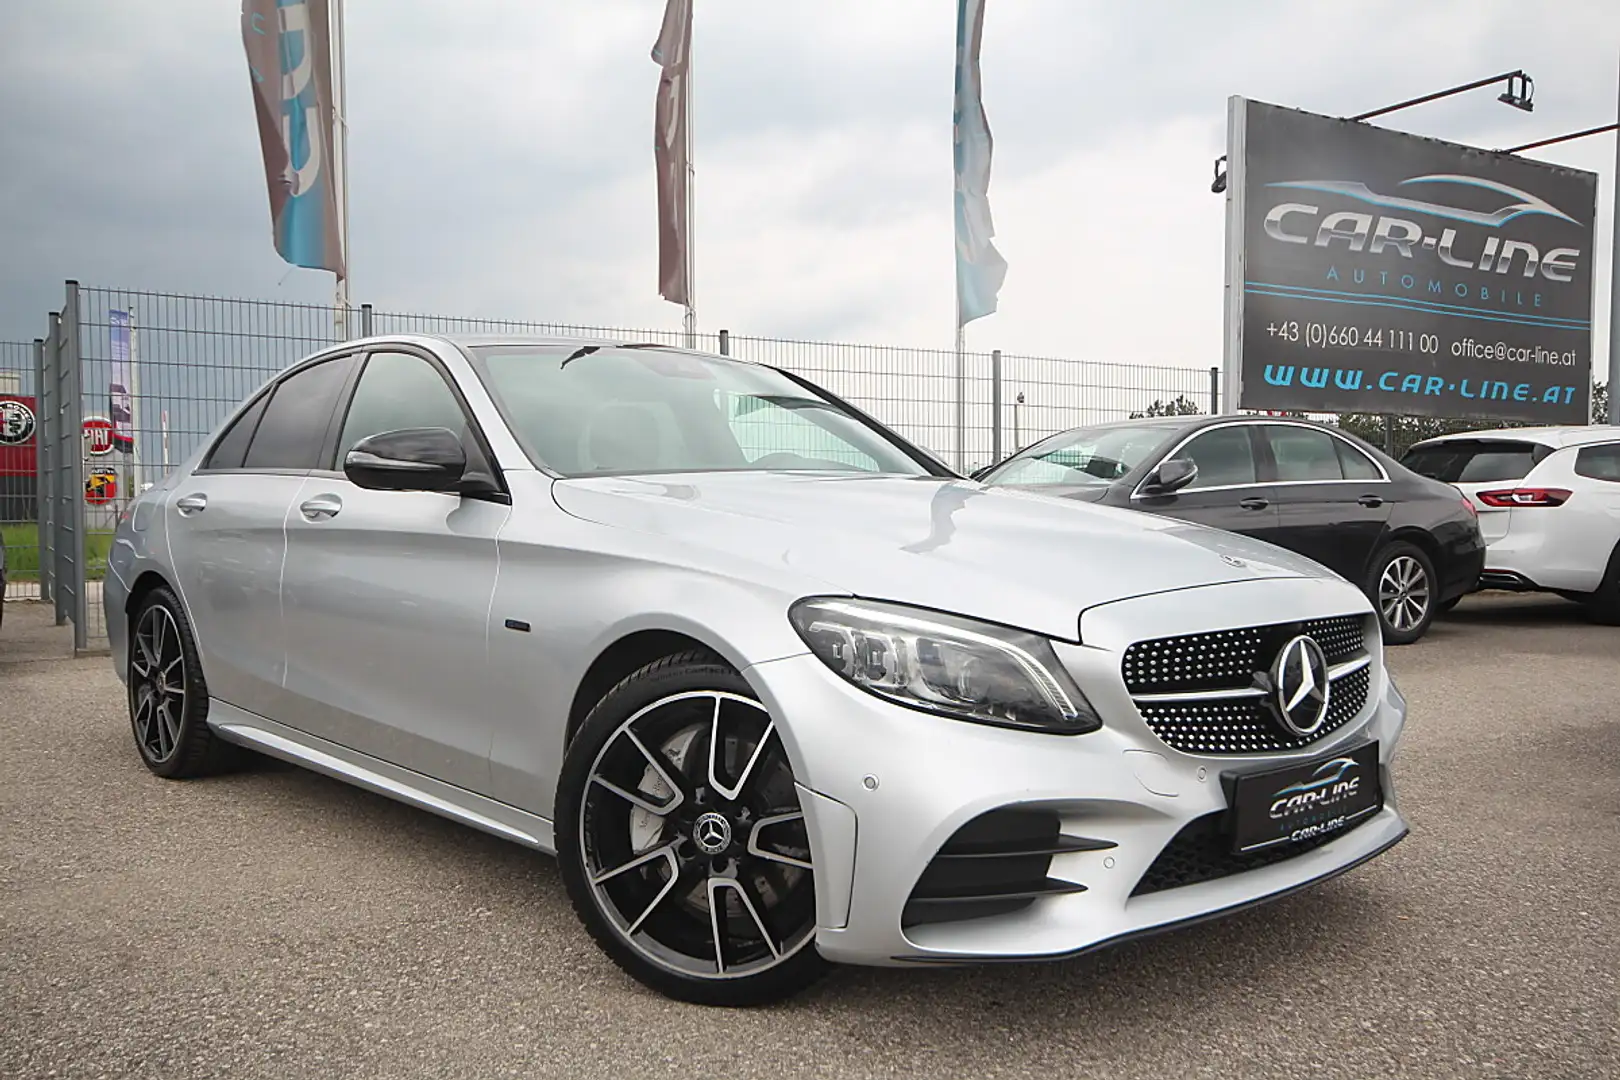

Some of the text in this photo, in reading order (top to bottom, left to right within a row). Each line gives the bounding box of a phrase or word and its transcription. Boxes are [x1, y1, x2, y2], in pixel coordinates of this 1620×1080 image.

[1327, 265, 1542, 308] AUTOMOBILE
[1266, 322, 1439, 354] +43 (0)660 44 111 00
[1451, 340, 1577, 366] office@car-line.at
